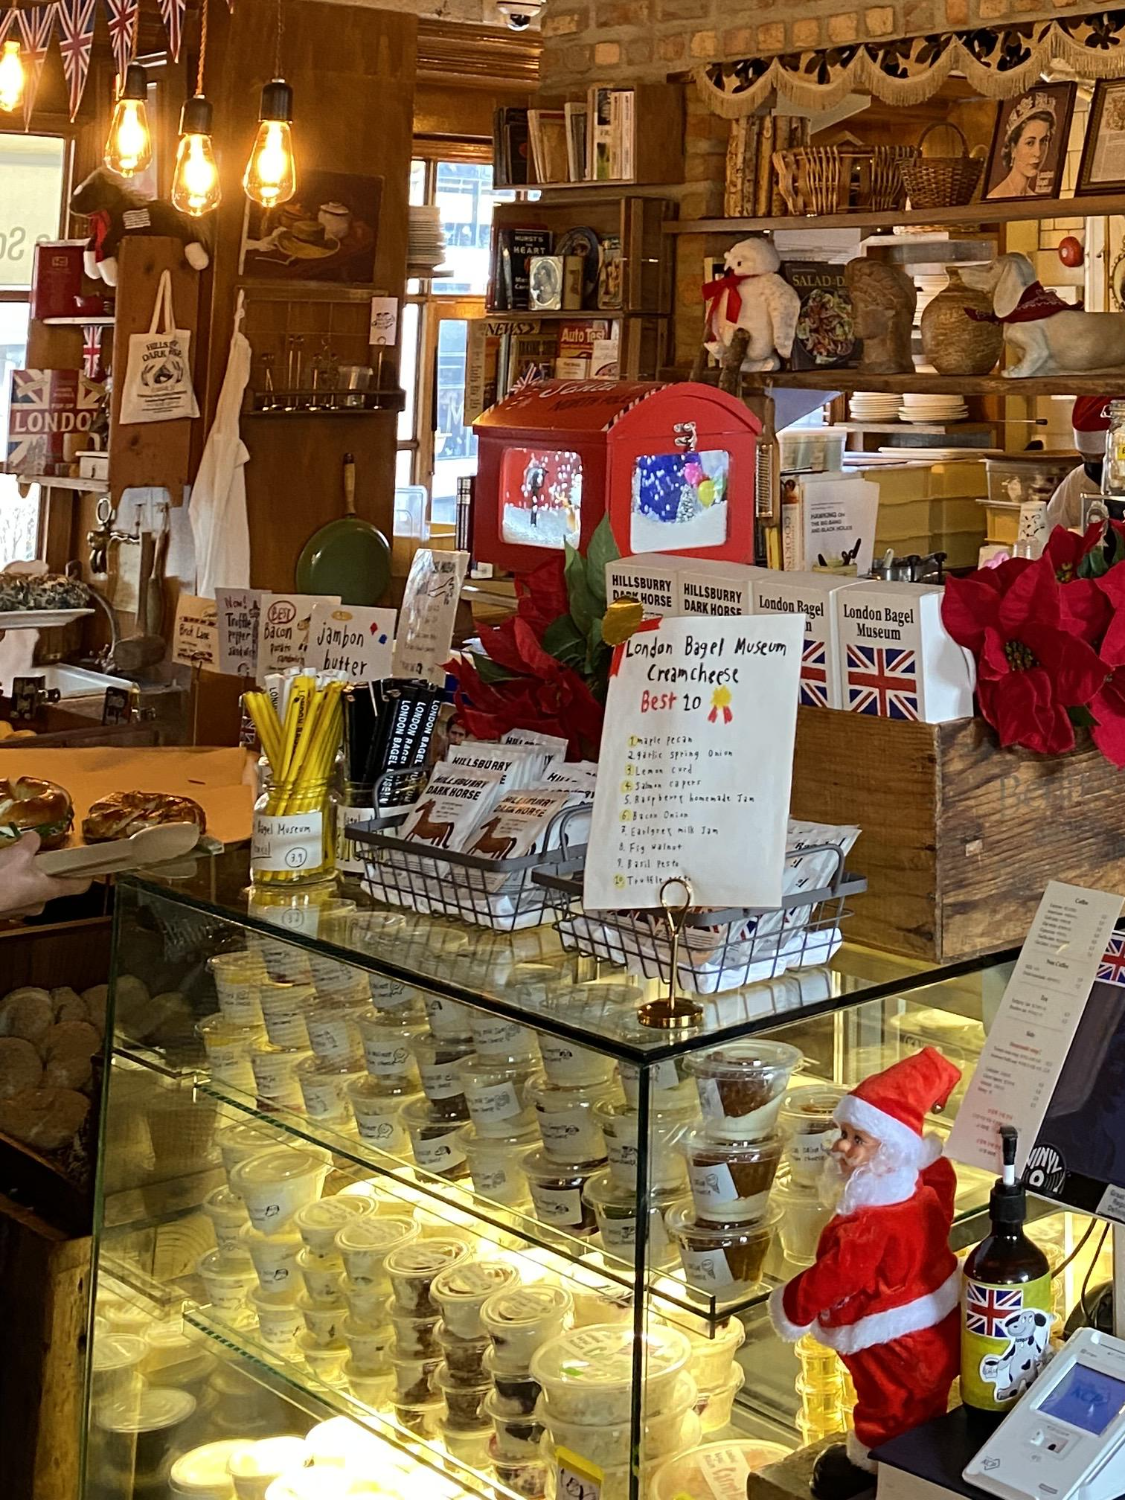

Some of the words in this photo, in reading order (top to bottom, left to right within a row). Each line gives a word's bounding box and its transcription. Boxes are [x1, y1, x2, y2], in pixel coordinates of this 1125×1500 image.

[513, 246, 546, 254] HEART
[485, 322, 528, 337] NEWS
[561, 327, 586, 343] Auto
[612, 574, 672, 593] HILLSBURRY
[640, 592, 673, 608] HORSE
[683, 583, 743, 604] HILLSBURRY
[684, 598, 709, 615] DARK
[710, 602, 742, 615] HORSE
[758, 595, 796, 613] London
[797, 598, 825, 617] Bagel
[843, 603, 883, 622] London
[883, 607, 915, 627] Bagel
[264, 621, 293, 640] Bacon
[317, 622, 364, 650] jambon
[856, 621, 902, 641] Museum
[625, 638, 674, 660] London
[684, 635, 725, 660] Bagel
[735, 637, 787, 657] Museum
[323, 652, 368, 677] butter
[641, 691, 678, 713] Best
[395, 699, 411, 736] LONDON
[666, 734, 693, 747] pecan
[451, 756, 513, 772] HILLSBURRY
[425, 785, 450, 797] DARK
[449, 787, 482, 801] HORSE
[277, 822, 312, 836] Museum
